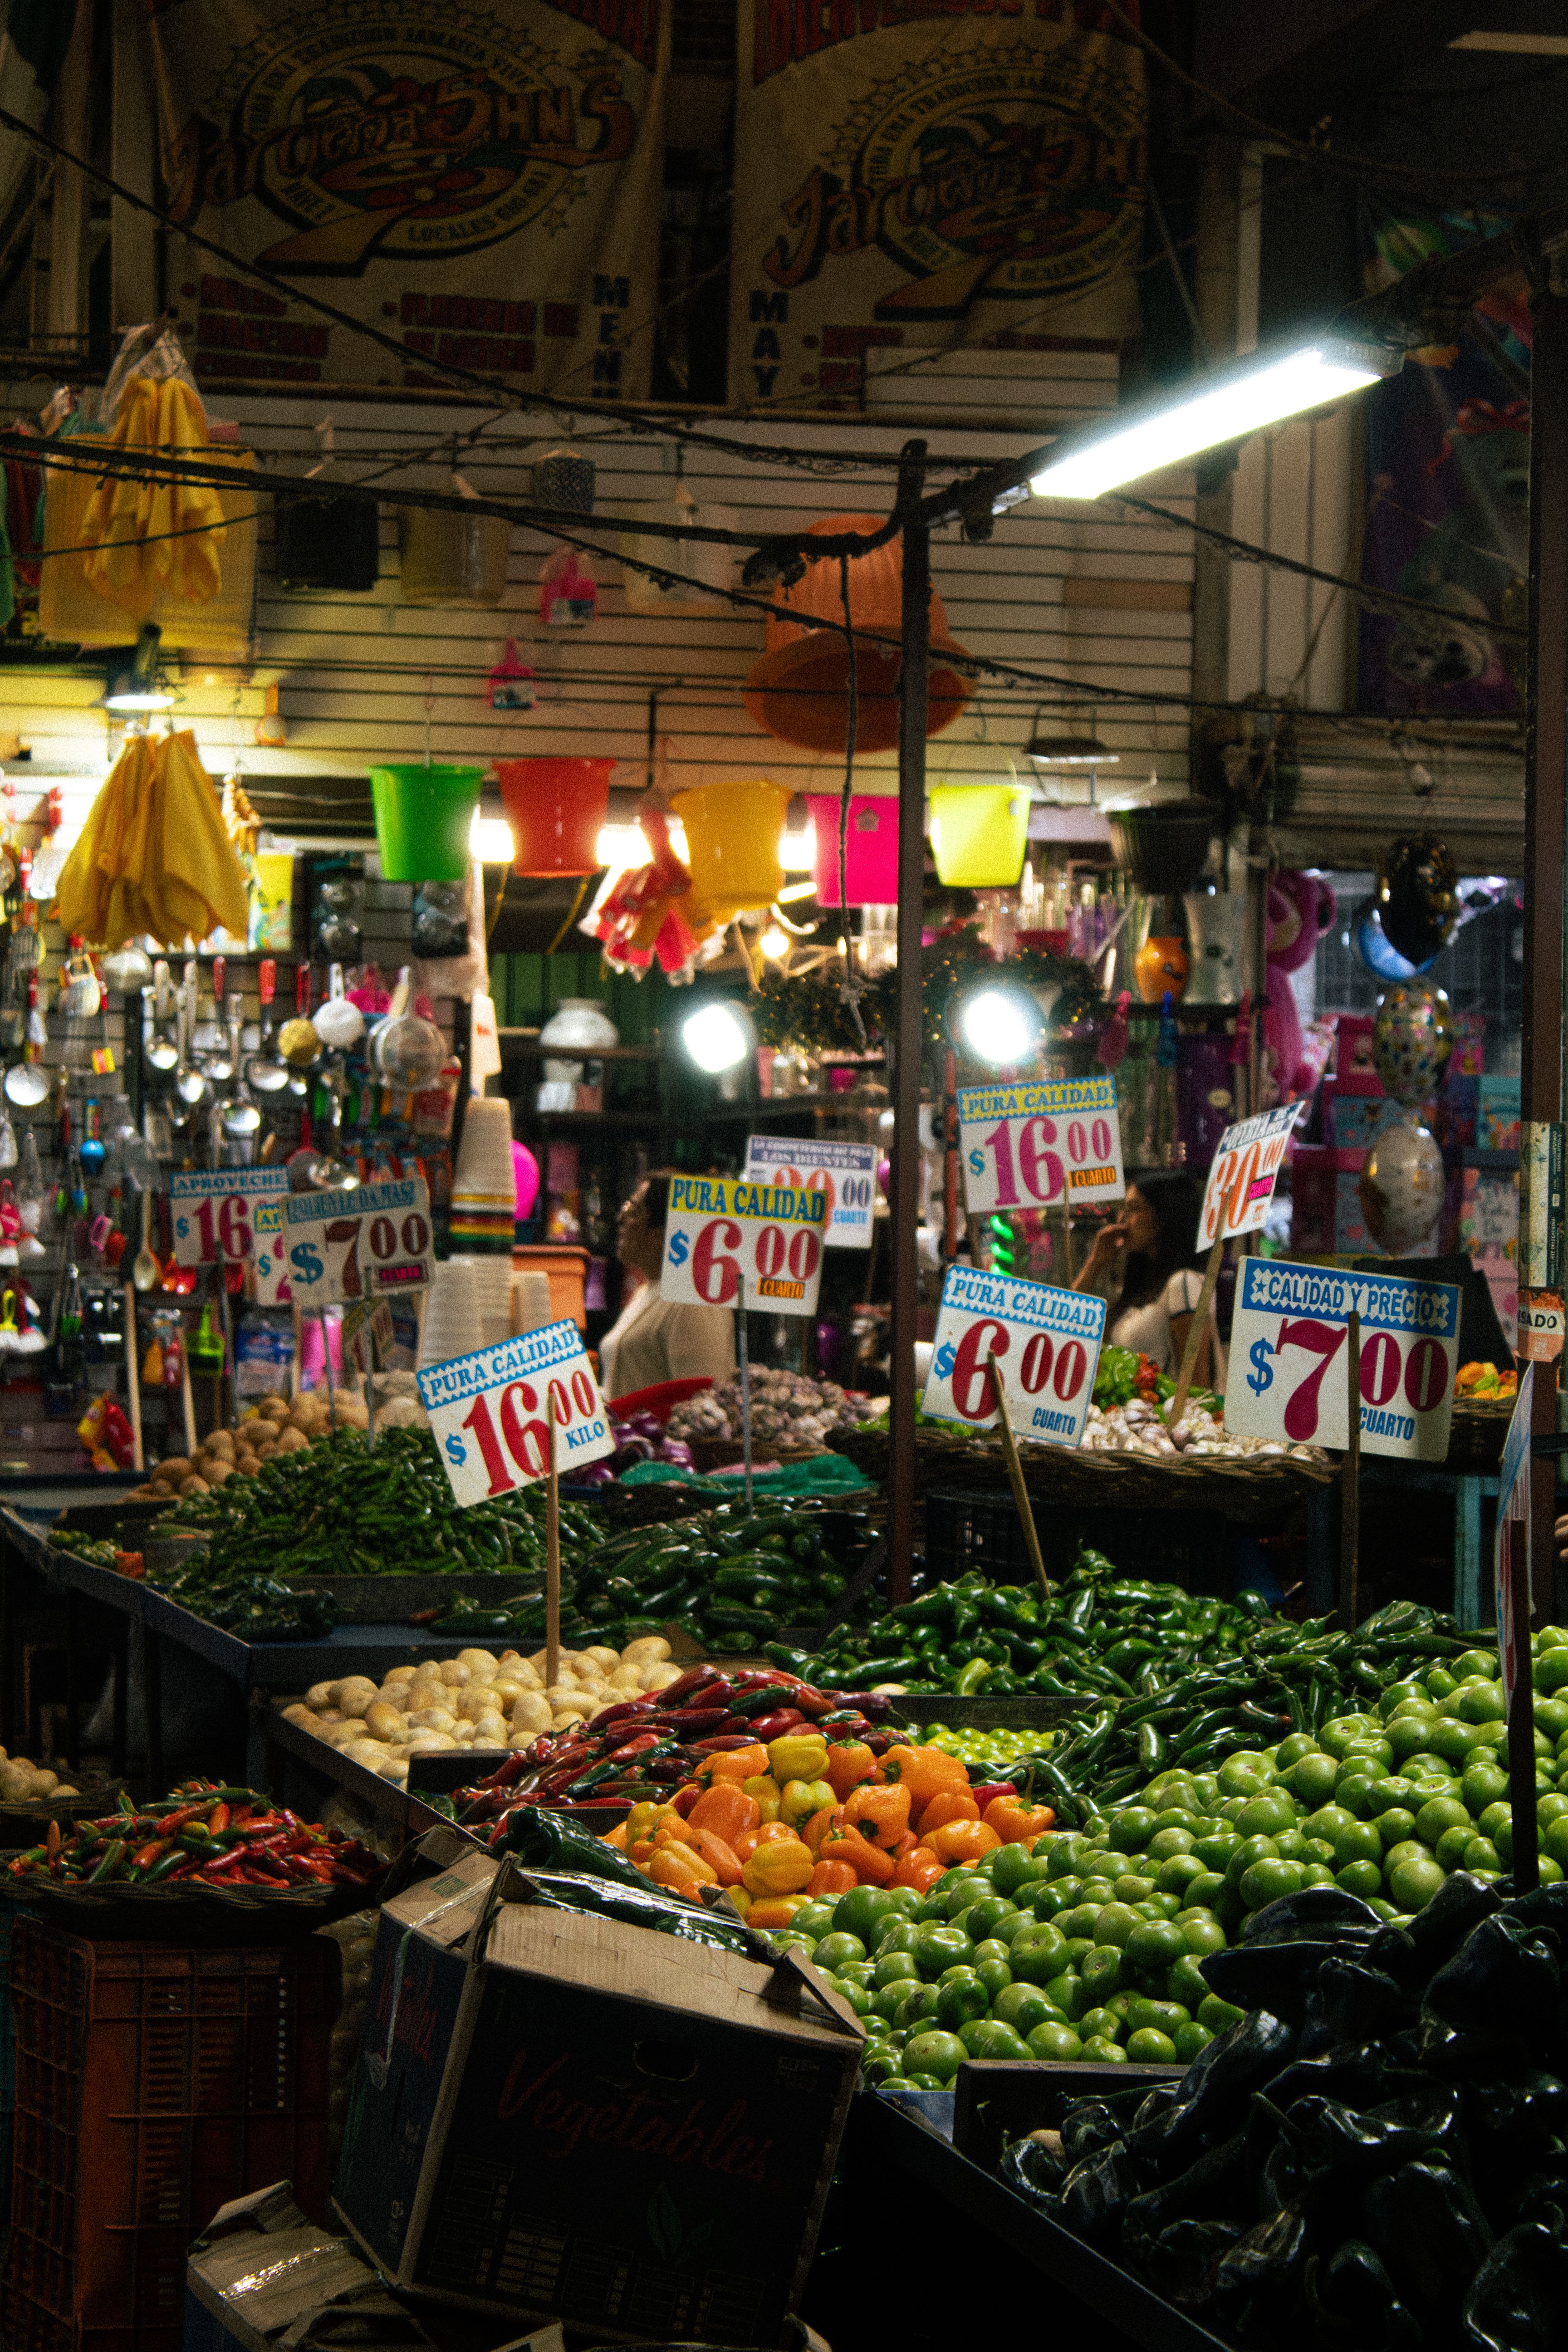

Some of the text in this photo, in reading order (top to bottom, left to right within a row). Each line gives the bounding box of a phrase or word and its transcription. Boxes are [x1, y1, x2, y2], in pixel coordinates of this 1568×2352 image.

[968, 1086, 1109, 1115] PURA CALIDAD
[175, 1172, 284, 1192] APROVECHE
[671, 1178, 727, 1214] PURA
[733, 1185, 826, 1223] CALIDAD
[763, 1279, 804, 1300] CUARTO
[951, 1278, 1097, 1327] PURA CALIDAD
[1269, 1276, 1434, 1322] CALIDAD Y PRECIO
[429, 1329, 576, 1397] PURA CALIDAD
[565, 1420, 605, 1450] KILO
[1032, 1407, 1077, 1436] CUARTO
[1359, 1406, 1415, 1441] CUARTO
[497, 2047, 774, 2185] Vegetables
